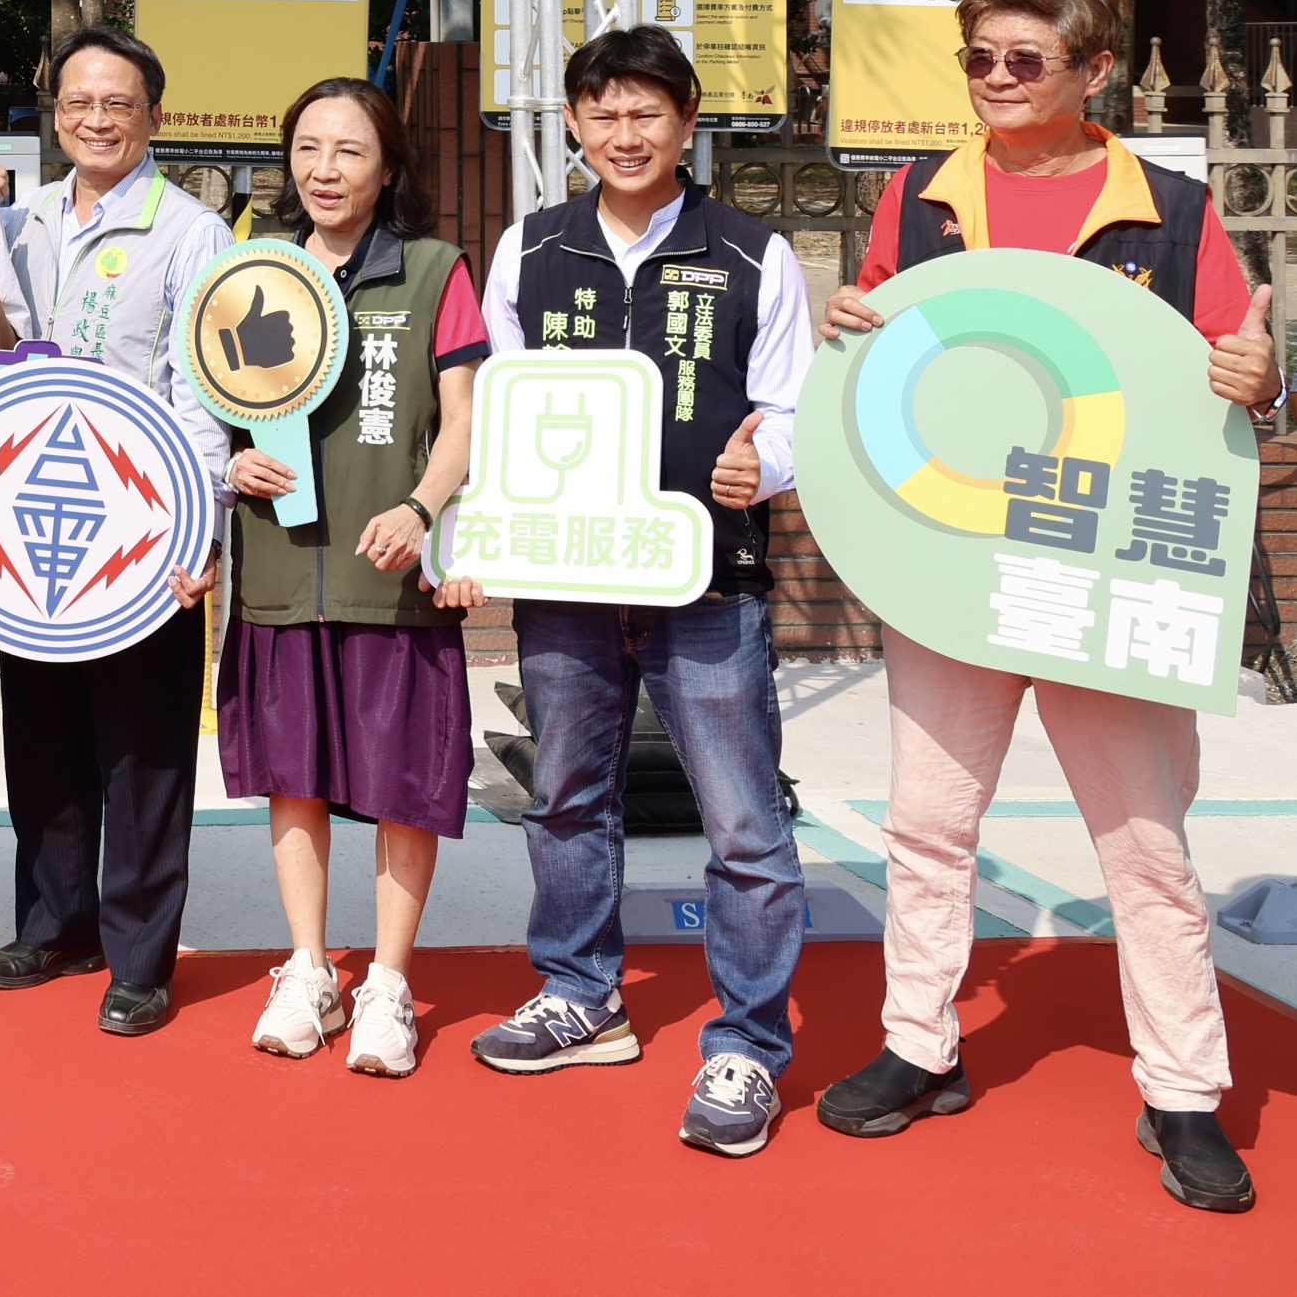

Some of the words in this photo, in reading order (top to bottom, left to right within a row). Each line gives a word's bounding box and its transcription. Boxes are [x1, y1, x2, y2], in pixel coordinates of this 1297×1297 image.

[681, 269, 725, 287] DPP
[371, 315, 407, 326] DPP
[572, 288, 597, 340] 特助
[664, 290, 690, 357] 郭國文
[692, 293, 715, 361] 立法委員
[357, 333, 399, 446] 林俊憲
[675, 360, 696, 422] 服務團隊
[454, 510, 677, 570] 充電服務
[1003, 446, 1232, 578] 智慧
[987, 552, 1224, 687] 臺南
